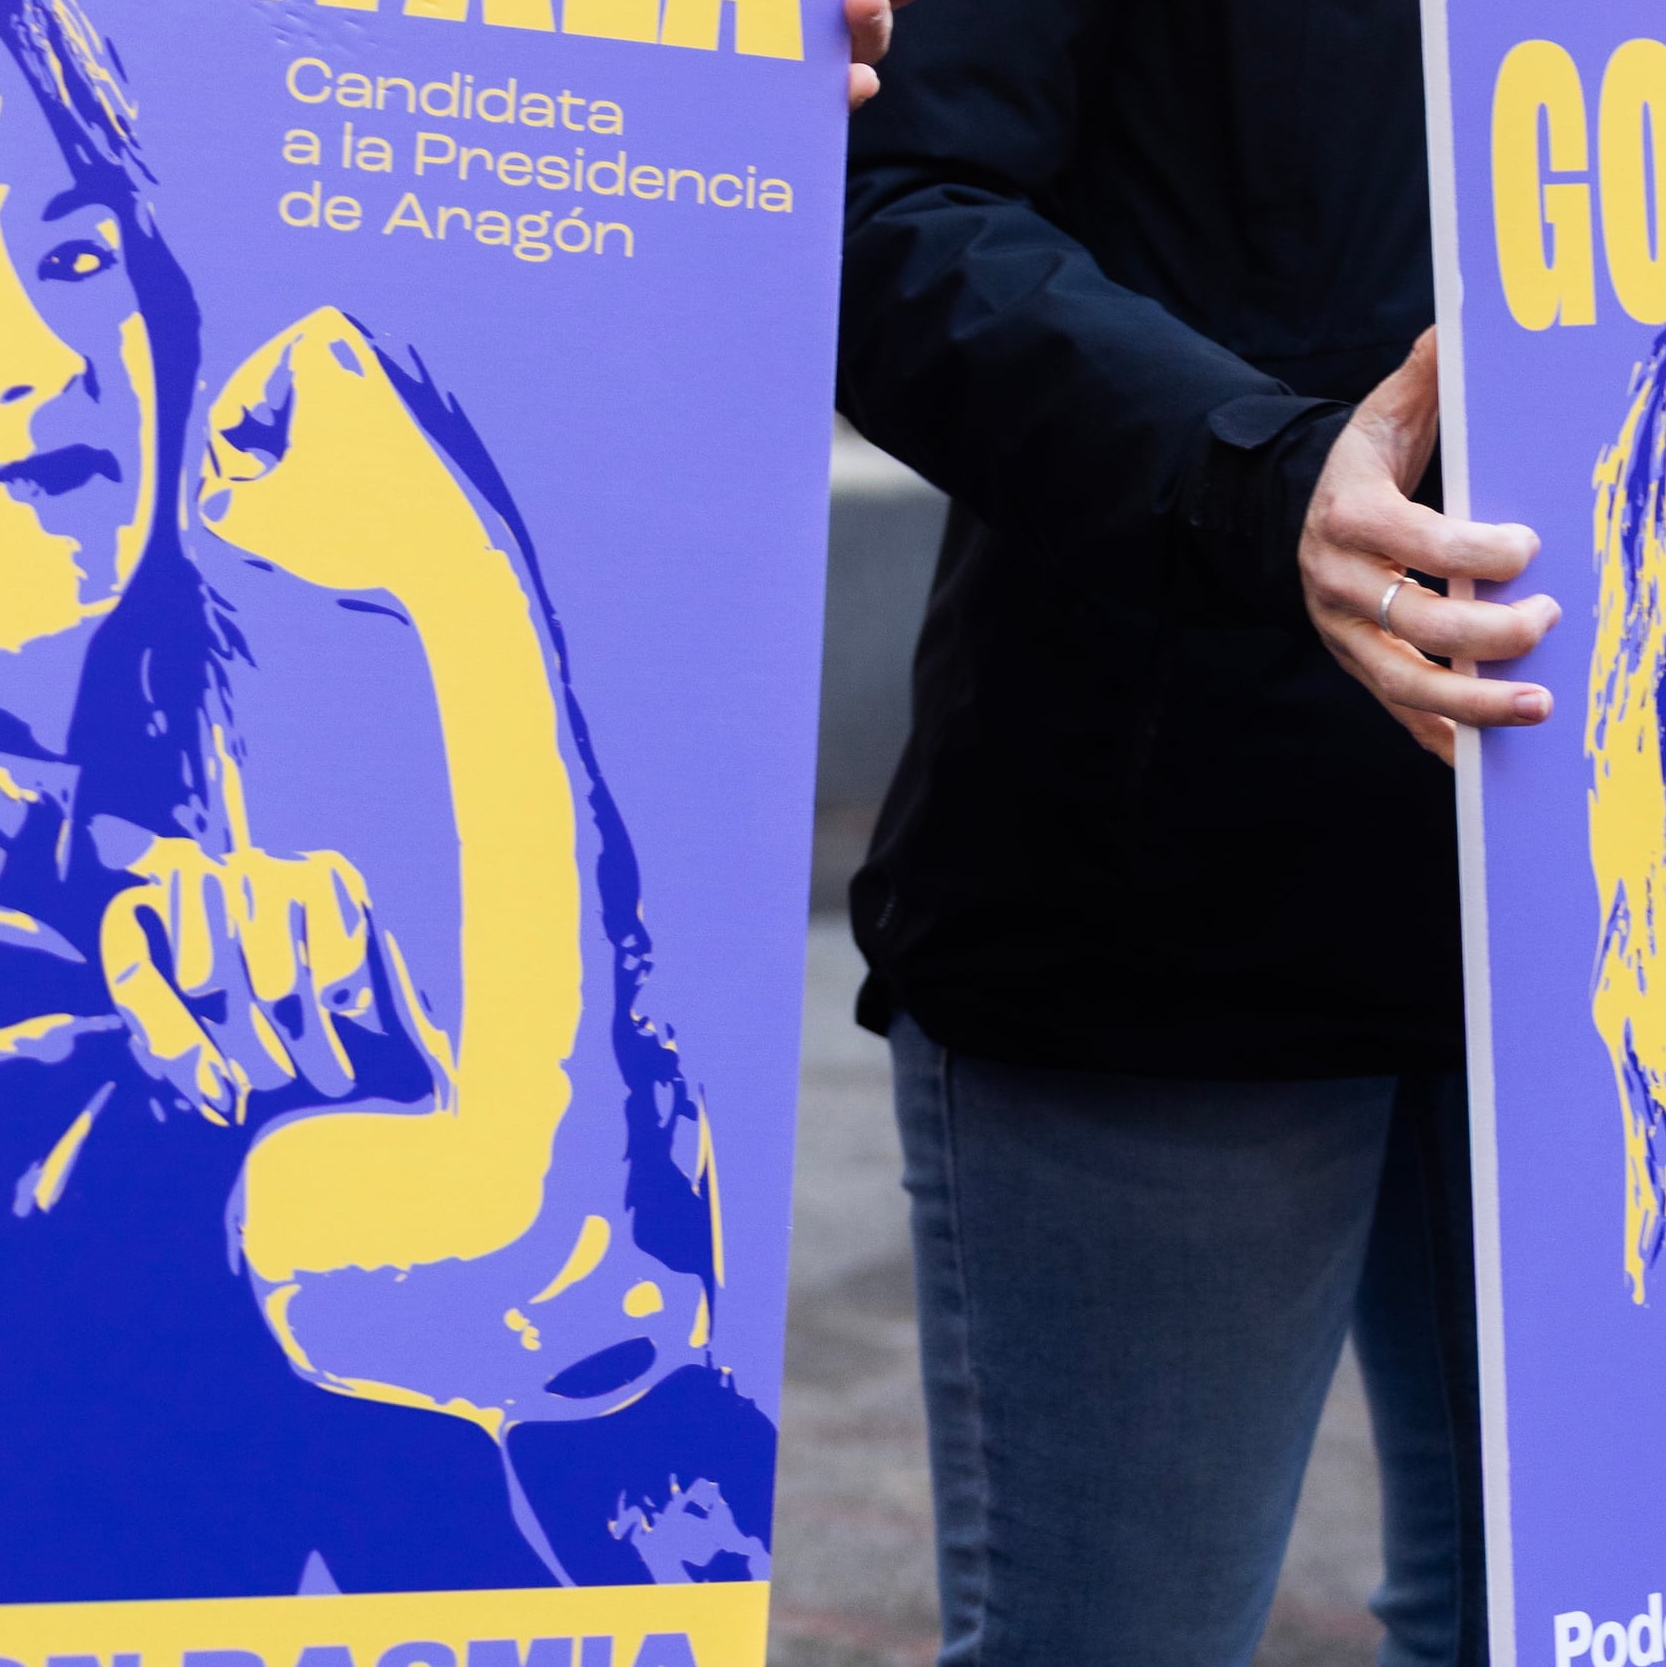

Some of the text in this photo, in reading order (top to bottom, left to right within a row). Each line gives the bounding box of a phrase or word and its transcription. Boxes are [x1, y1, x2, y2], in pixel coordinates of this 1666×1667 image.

[285, 56, 624, 133] Candidata
[282, 122, 794, 213] a la Presidencia
[278, 180, 634, 263] de Aragón
